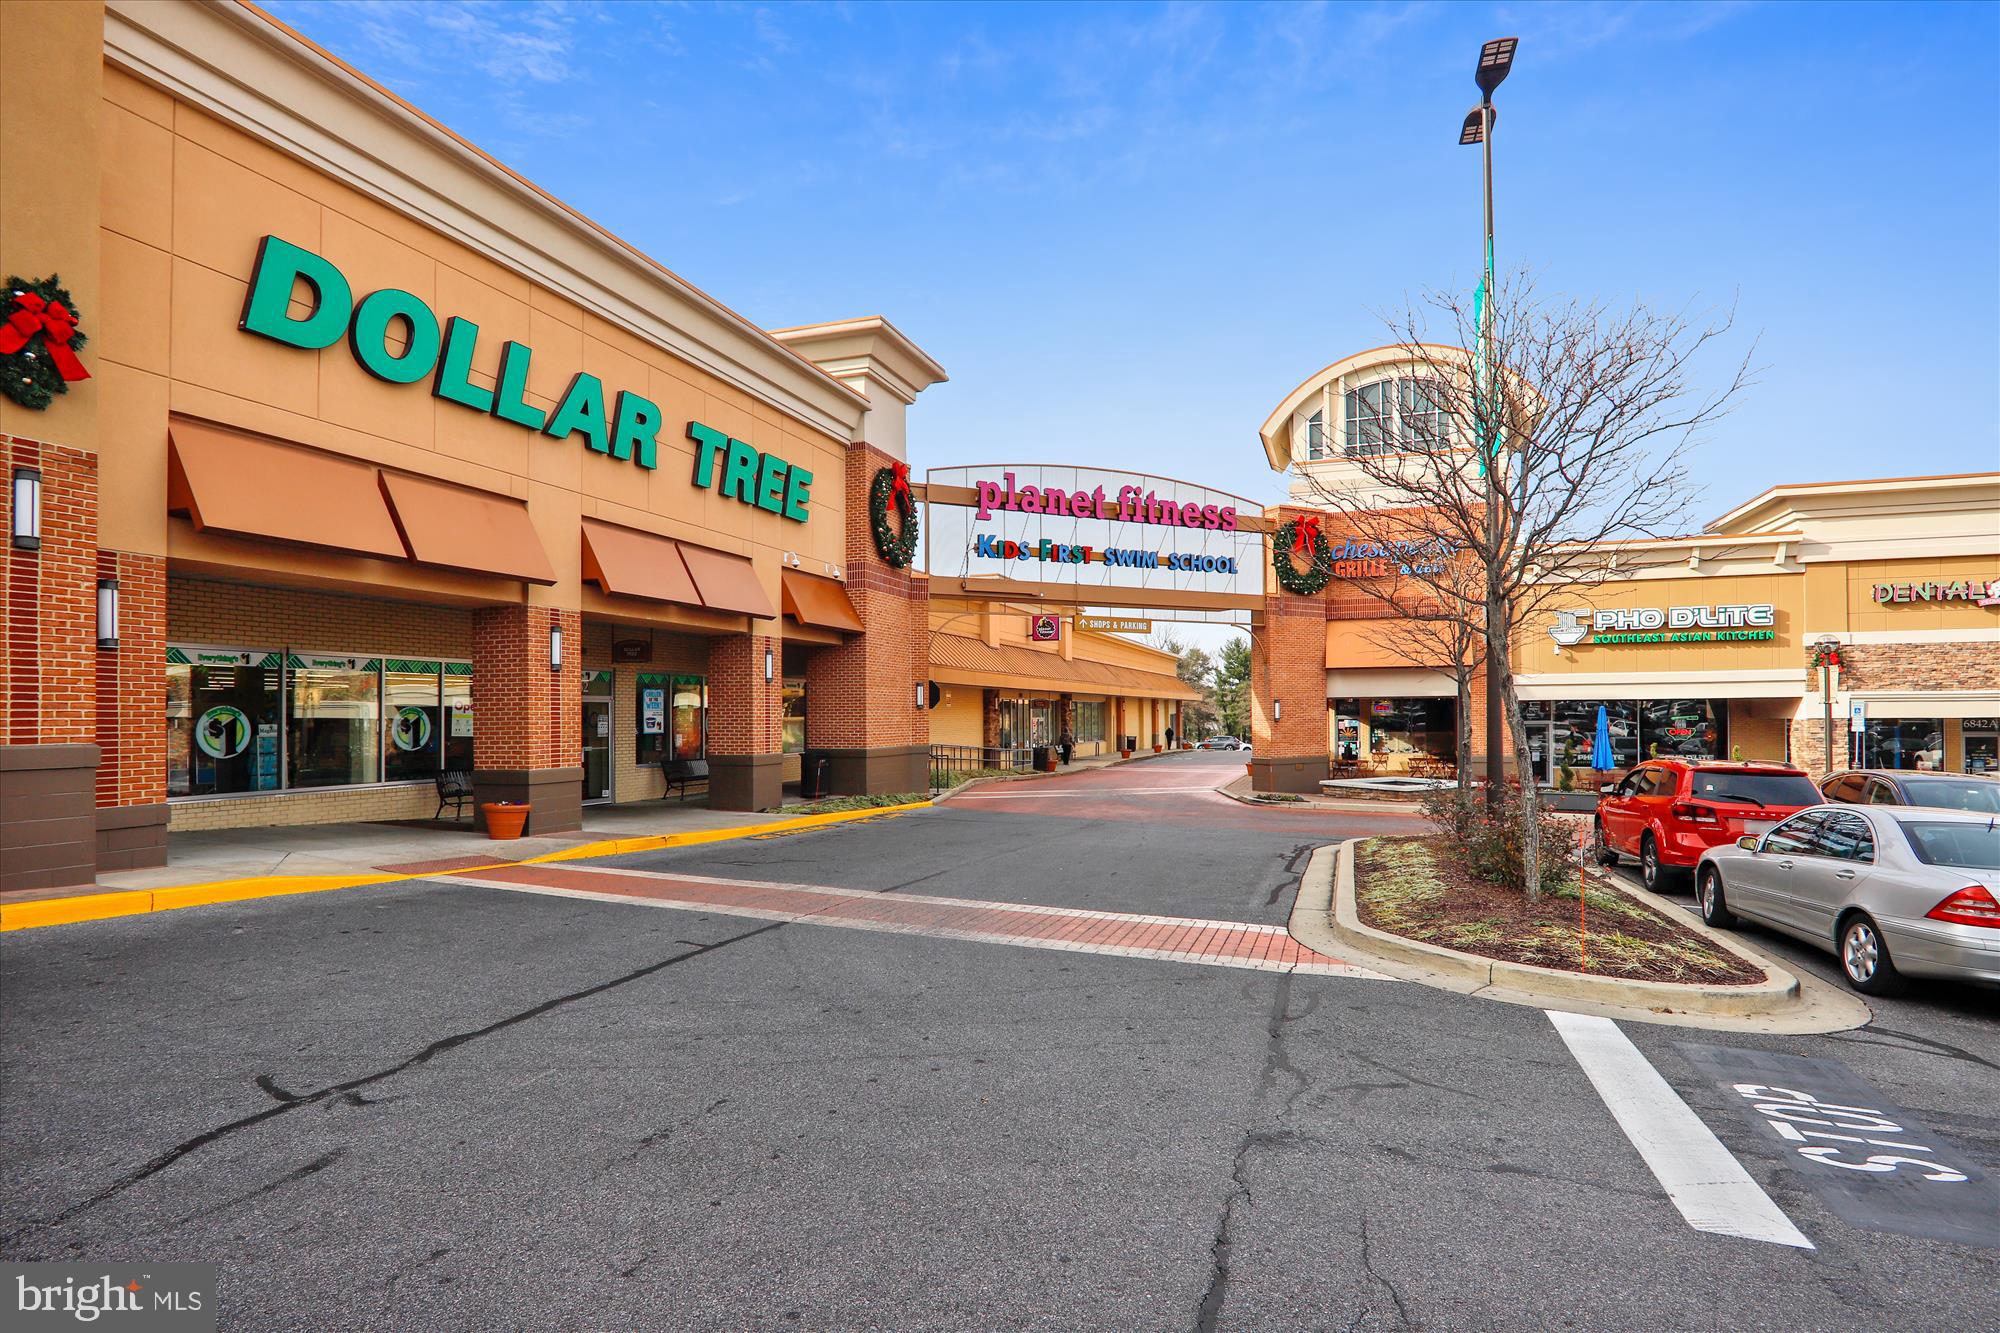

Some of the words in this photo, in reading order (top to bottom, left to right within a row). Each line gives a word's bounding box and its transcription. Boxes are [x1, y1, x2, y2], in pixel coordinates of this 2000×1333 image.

[239, 235, 662, 470] DOLLAR
[687, 421, 813, 522] TREE
[976, 472, 1105, 520] planet
[1117, 485, 1237, 531] fitness
[977, 534, 1031, 560] KIDS
[1039, 539, 1093, 565] FIRST
[1104, 547, 1158, 569] SWIM
[1168, 553, 1238, 574] SCHOOL
[1872, 581, 1986, 603] DENTAL
[1089, 620, 1111, 629] SHOPS
[1112, 621, 1118, 629] &
[1120, 621, 1147, 631] PARKING
[1593, 607, 1664, 631] PHO
[1592, 632, 1665, 645] SOUTHEAST
[1671, 632, 1717, 642] ASIAN
[1717, 630, 1775, 642] KITCHEN
[1733, 1085, 1968, 1182] STOP
